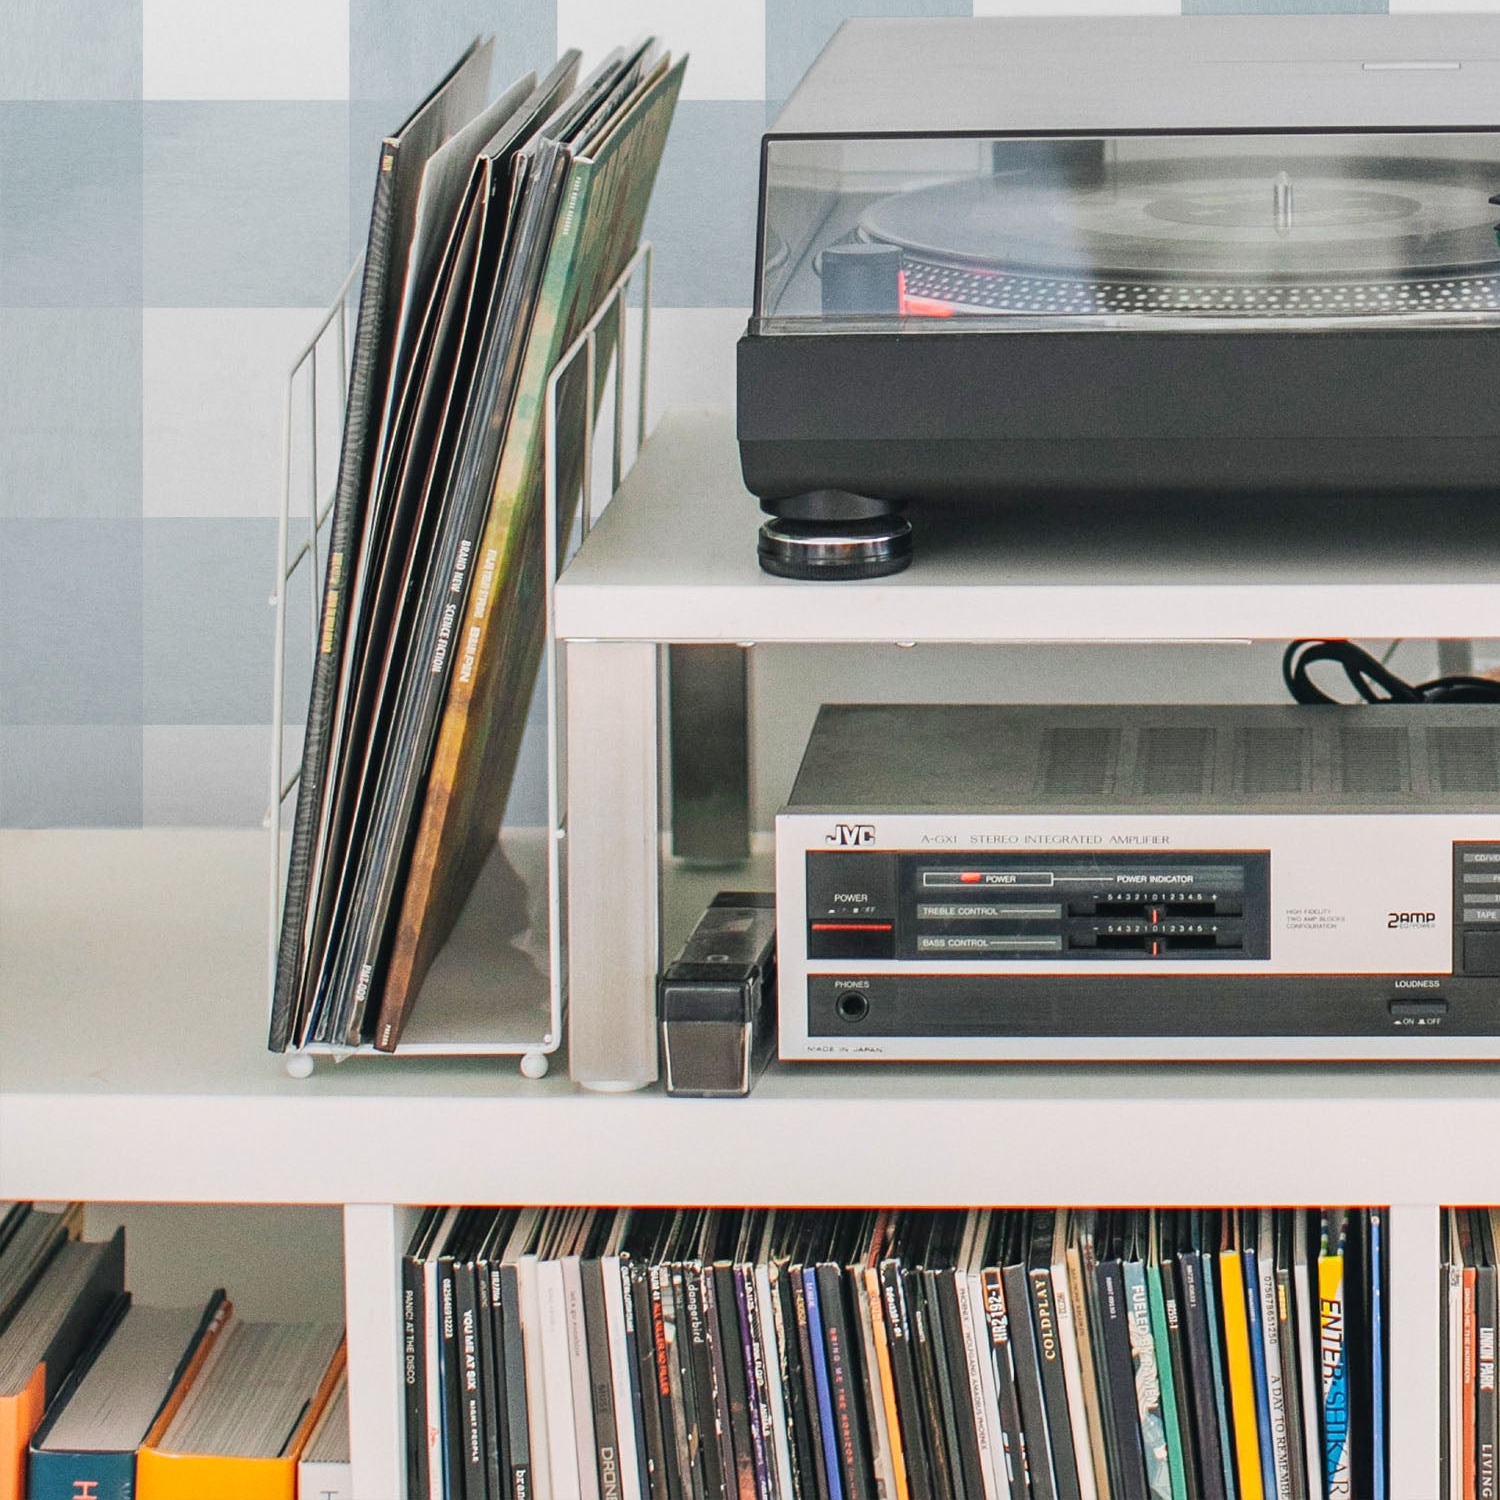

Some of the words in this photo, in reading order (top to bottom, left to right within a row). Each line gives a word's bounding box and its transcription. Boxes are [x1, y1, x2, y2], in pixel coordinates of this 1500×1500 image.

[454, 540, 471, 571] BRAND
[451, 572, 463, 592] NEW
[441, 604, 456, 637] SCIENCE
[432, 637, 448, 672] FICTION
[825, 824, 876, 846] JVC
[921, 835, 957, 844] A-GX1
[970, 835, 1019, 844] STEREO
[1024, 835, 1102, 844] INTEGRATED
[1109, 835, 1170, 844] AMPLIFIER
[1117, 875, 1147, 883] POWER
[1149, 875, 1193, 883] INDICATOR
[834, 894, 868, 902] POWER
[923, 907, 955, 915] TREBLE
[957, 907, 998, 915] CONTROL
[1476, 911, 1496, 919] TAPE
[834, 980, 870, 988] PHONES
[1395, 980, 1440, 988] LOUDNESS
[405, 1290, 413, 1320] PANIC!
[653, 1302, 662, 1319] ALL
[688, 1284, 704, 1343] dangerbird
[959, 1288, 969, 1321] PHOENIX
[986, 1283, 1008, 1343] HR2192-1
[1131, 1285, 1147, 1332] FUELED
[406, 1322, 414, 1334] AT
[463, 1309, 473, 1333] YOU
[1034, 1279, 1056, 1360] COLDPLAY
[1464, 1314, 1471, 1327] ME
[406, 1335, 414, 1353] THE
[465, 1334, 474, 1354] ME
[655, 1320, 665, 1350] KILLER
[829, 1328, 841, 1362] BRING
[1138, 1336, 1150, 1355] BY
[1479, 1327, 1493, 1360] LINKIN
[466, 1354, 475, 1369] AT
[658, 1350, 666, 1365] NO
[965, 1332, 978, 1377] WOLFGANG
[406, 1355, 415, 1384] DISCO
[466, 1370, 476, 1392] SIX
[660, 1366, 670, 1397] FILLER
[755, 1361, 764, 1386] FLOYD
[834, 1367, 843, 1384] ME
[1271, 1375, 1280, 1384] A
[1480, 1362, 1494, 1391] PARK
[971, 1379, 983, 1415] AMADEUS
[1142, 1360, 1158, 1409] RAMEN
[837, 1389, 847, 1410] THE
[1272, 1388, 1284, 1415] DAY
[469, 1400, 477, 1427] NIGHT
[1275, 1418, 1285, 1433] TO
[471, 1429, 479, 1463] PEOPLE
[841, 1413, 853, 1465] HORIZON
[976, 1417, 988, 1450] PHOENIX
[1325, 1392, 1349, 1500] SHIKAR
[1482, 1444, 1493, 1498] LIVING
